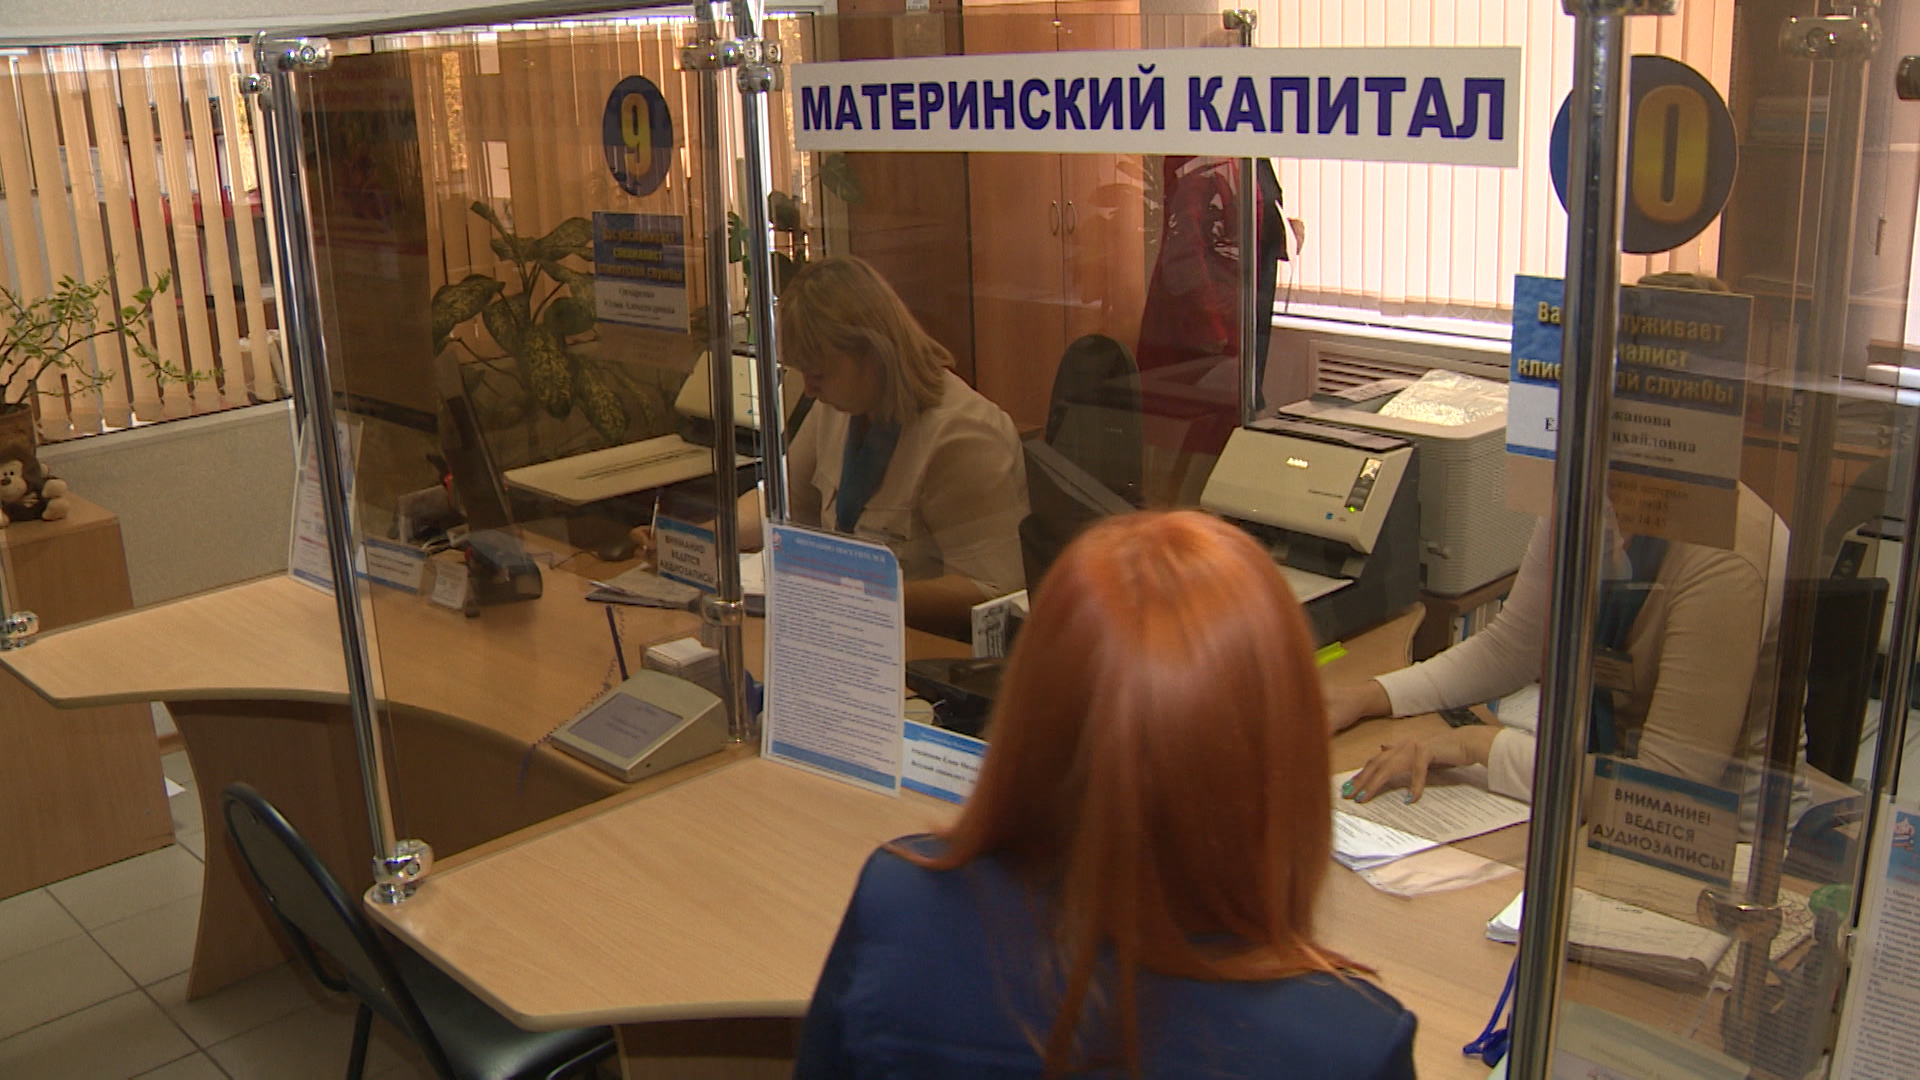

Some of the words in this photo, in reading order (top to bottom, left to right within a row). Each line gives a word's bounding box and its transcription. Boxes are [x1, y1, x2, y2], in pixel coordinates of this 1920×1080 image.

[801, 64, 1165, 130] МАТЕРИНСКИЙ
[1188, 76, 1505, 140] КАПИТАЛ
[621, 93, 652, 177] 9
[1632, 85, 1709, 223] 0
[1538, 301, 1561, 323] Ва
[1620, 313, 1725, 342] луживает
[1644, 375, 1734, 403] службы
[1612, 431, 1696, 453] ихайловна
[1625, 811, 1695, 842] ВЕДЕТСЯ
